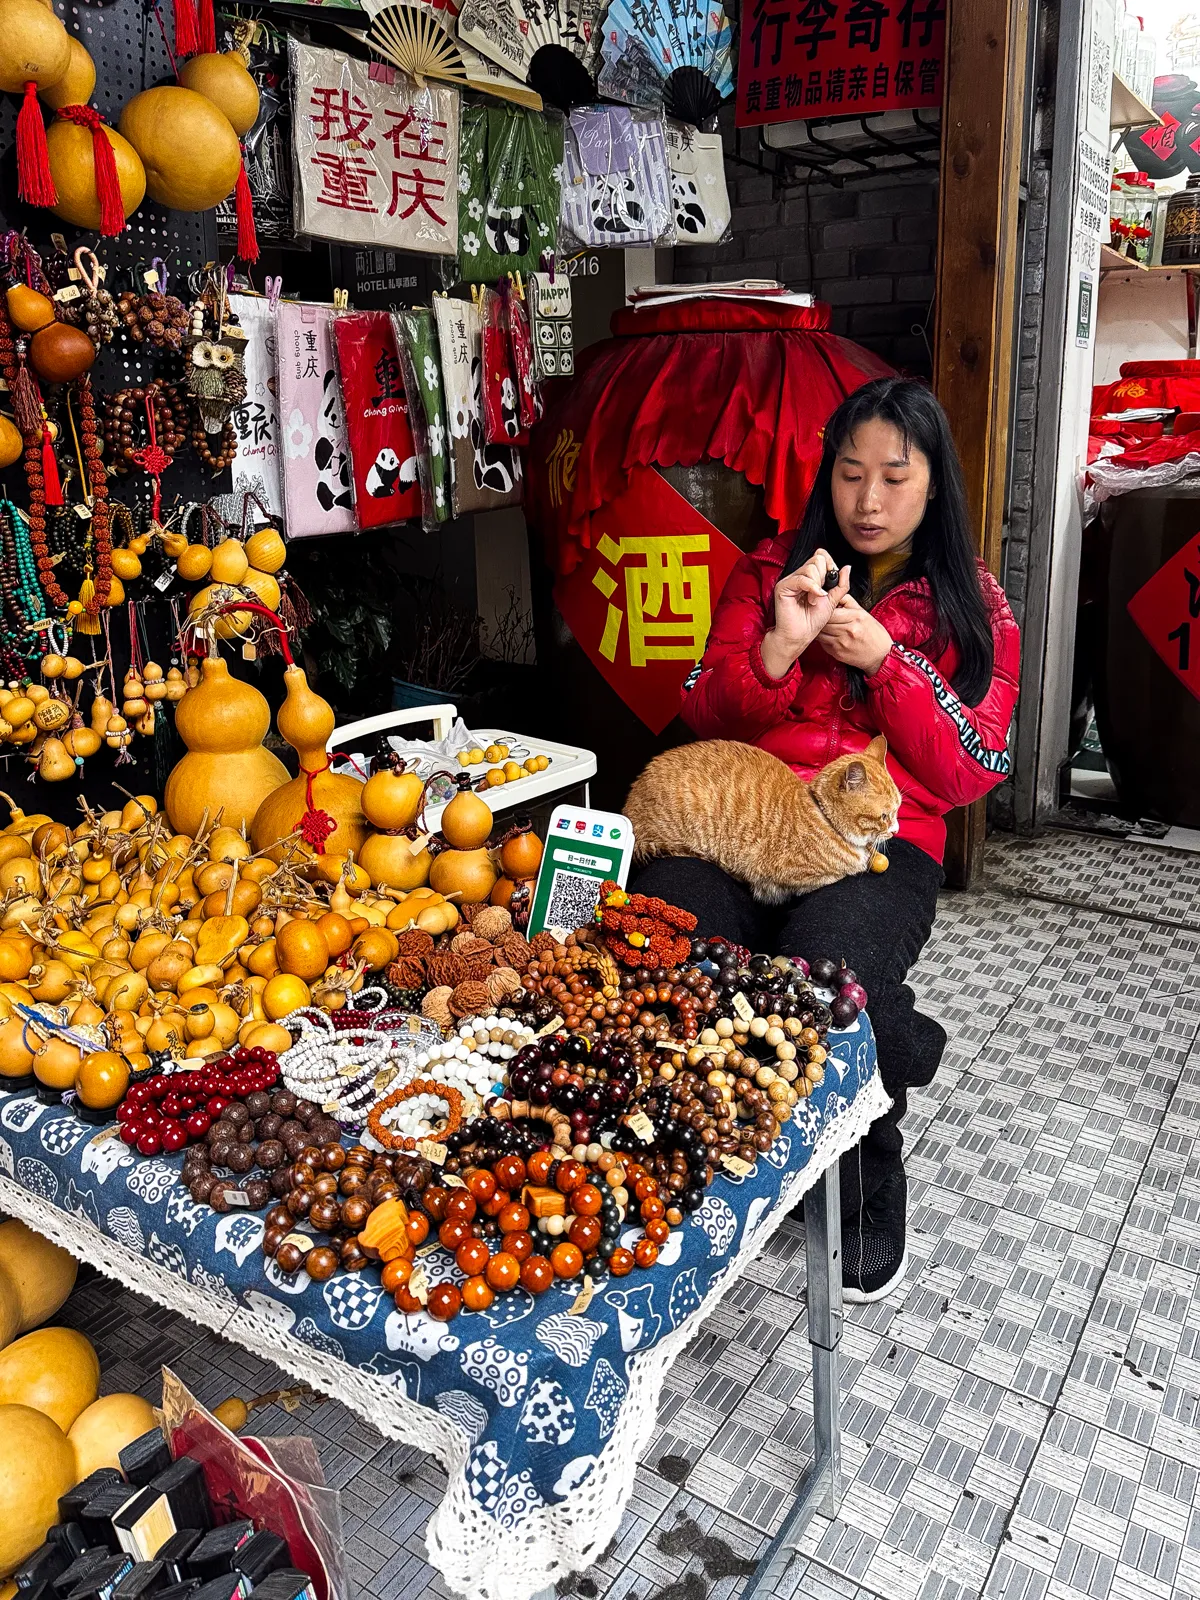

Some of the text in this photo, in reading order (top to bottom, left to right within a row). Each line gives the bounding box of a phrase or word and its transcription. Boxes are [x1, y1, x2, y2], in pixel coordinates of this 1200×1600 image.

[745, 57, 942, 115] 贵重物品请亲自保管
[309, 87, 447, 165] 我在
[667, 131, 695, 154] 重庆
[310, 151, 447, 227] 重庆
[356, 280, 388, 293] HOTEL
[540, 286, 570, 301] HAPPY
[293, 329, 302, 380] chong qing
[302, 329, 320, 378] 重庆
[454, 319, 469, 364] 重庆
[591, 532, 712, 667] 酒
